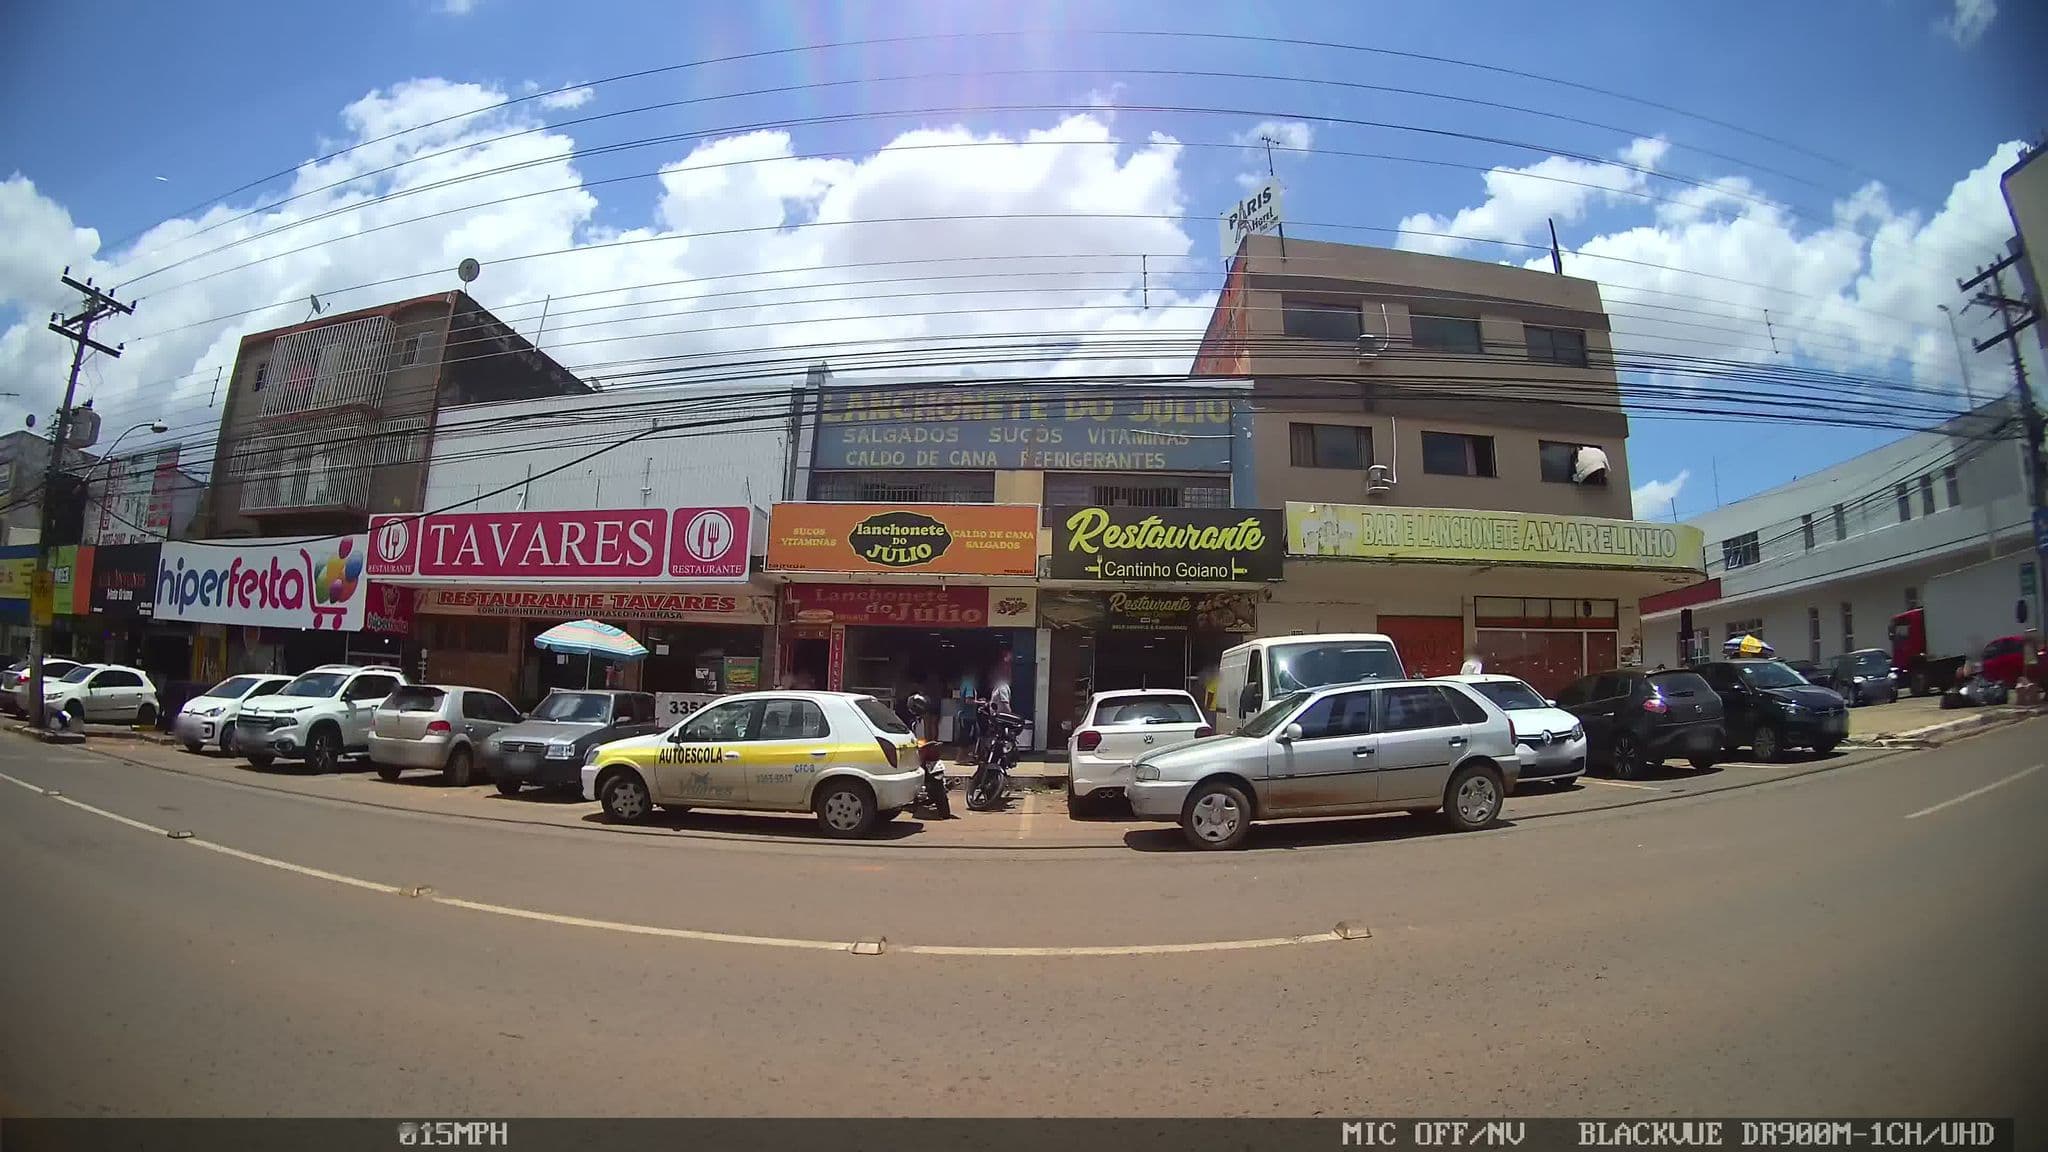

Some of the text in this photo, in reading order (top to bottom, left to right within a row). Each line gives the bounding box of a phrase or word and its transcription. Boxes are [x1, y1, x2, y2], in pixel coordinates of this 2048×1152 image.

[1228, 186, 1272, 231] PARIS
[821, 388, 1048, 423] LANCHONETE
[842, 427, 960, 444] SALGADOS
[1087, 428, 1190, 446] VITAMINAS
[845, 450, 905, 467] CALDO
[916, 450, 940, 467] DE
[949, 450, 998, 468] CANA
[792, 527, 827, 536] SUCOS
[856, 523, 945, 536] lanchonete
[952, 529, 1034, 540] CALDO DE CANA
[1066, 507, 1266, 555] Restaurante
[1361, 512, 1678, 559] BAR E LANCHONETE AMARELINHO
[429, 519, 654, 567] TAVARES
[780, 537, 837, 547] VITAMINAS
[892, 537, 908, 546] DO
[965, 540, 1021, 550] SALGADOS
[367, 564, 413, 574] RESTAURANTE
[671, 564, 743, 575] RESTAURANTE
[1104, 560, 1229, 579] Cantinho Goiano
[156, 555, 304, 616] hiperfesta
[437, 590, 737, 613] RESTAURANTE TAVARES
[815, 588, 950, 601] Lanchonete
[1109, 591, 1192, 613] Restaurante
[865, 601, 893, 613] do
[658, 748, 724, 765] AUTOESCOLA
